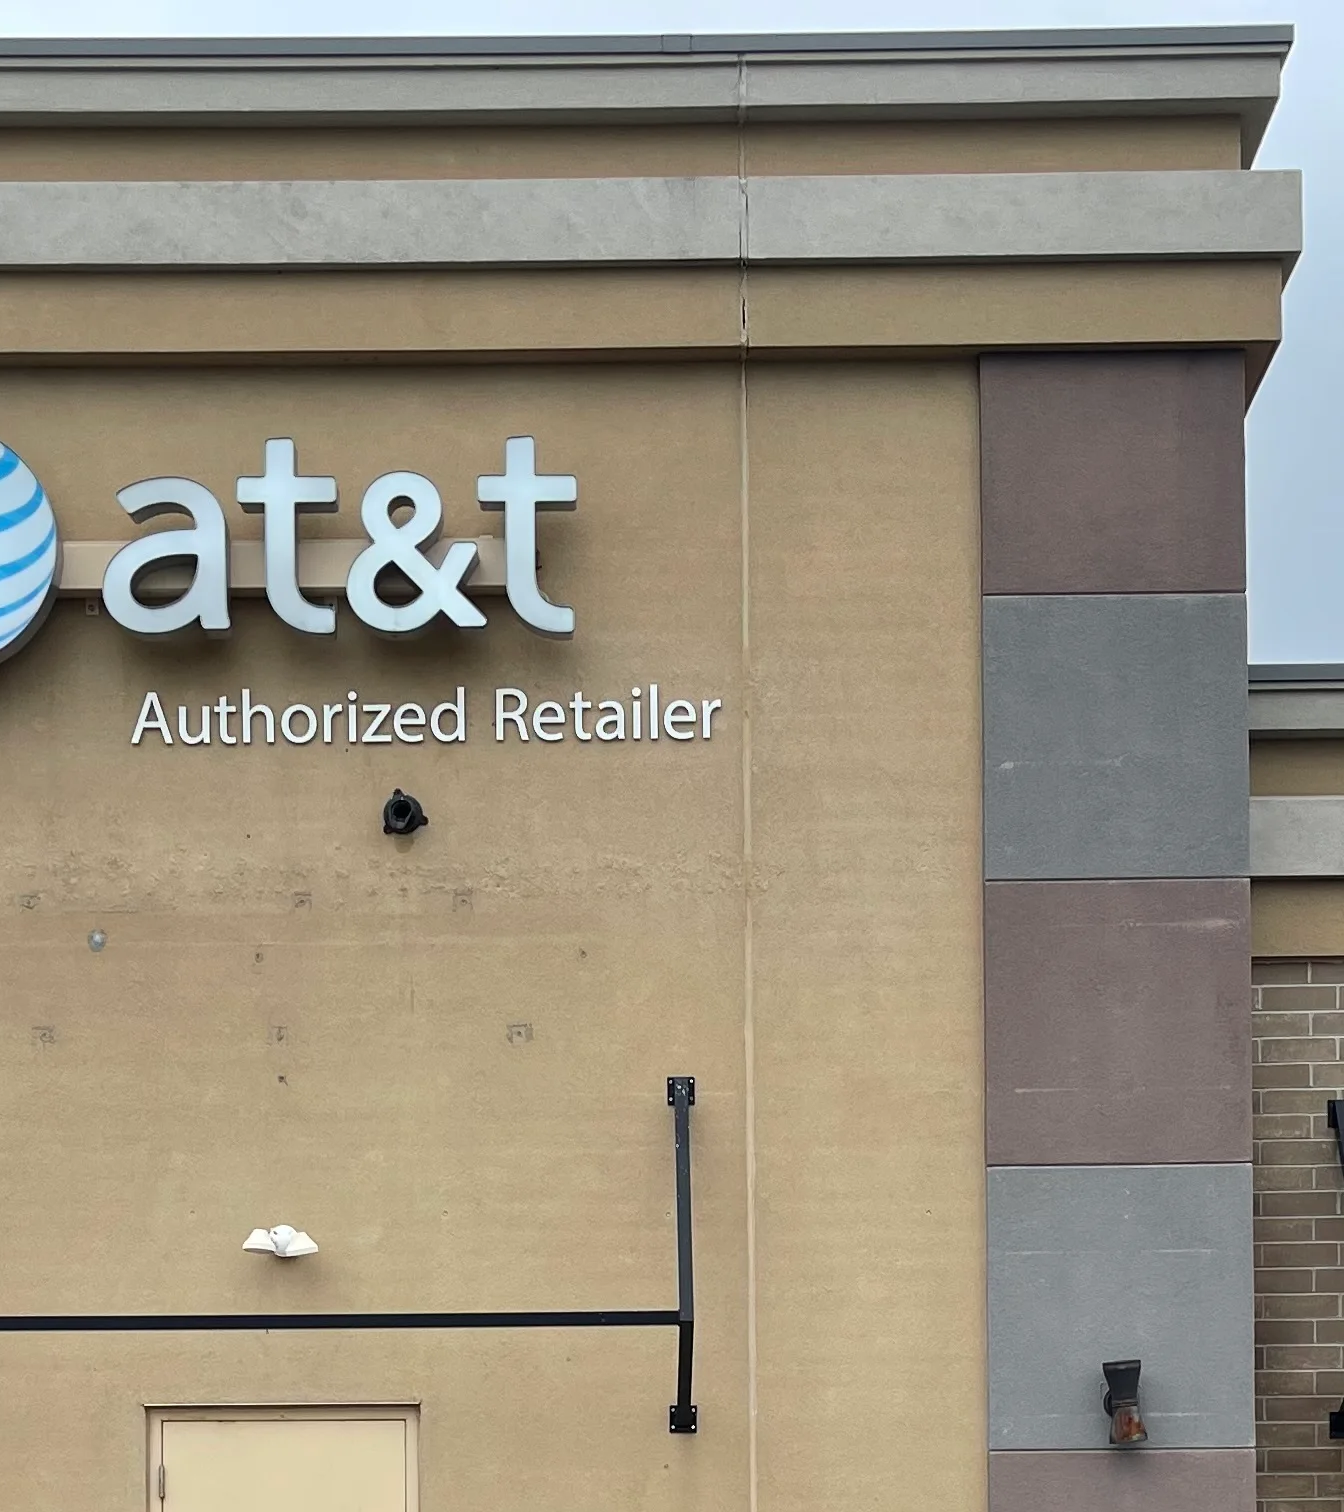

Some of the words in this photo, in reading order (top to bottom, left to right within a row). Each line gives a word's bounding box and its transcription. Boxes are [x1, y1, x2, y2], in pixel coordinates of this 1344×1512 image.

[102, 435, 578, 637] at&t
[130, 686, 468, 745] Authorized
[493, 684, 722, 741] Retailer
